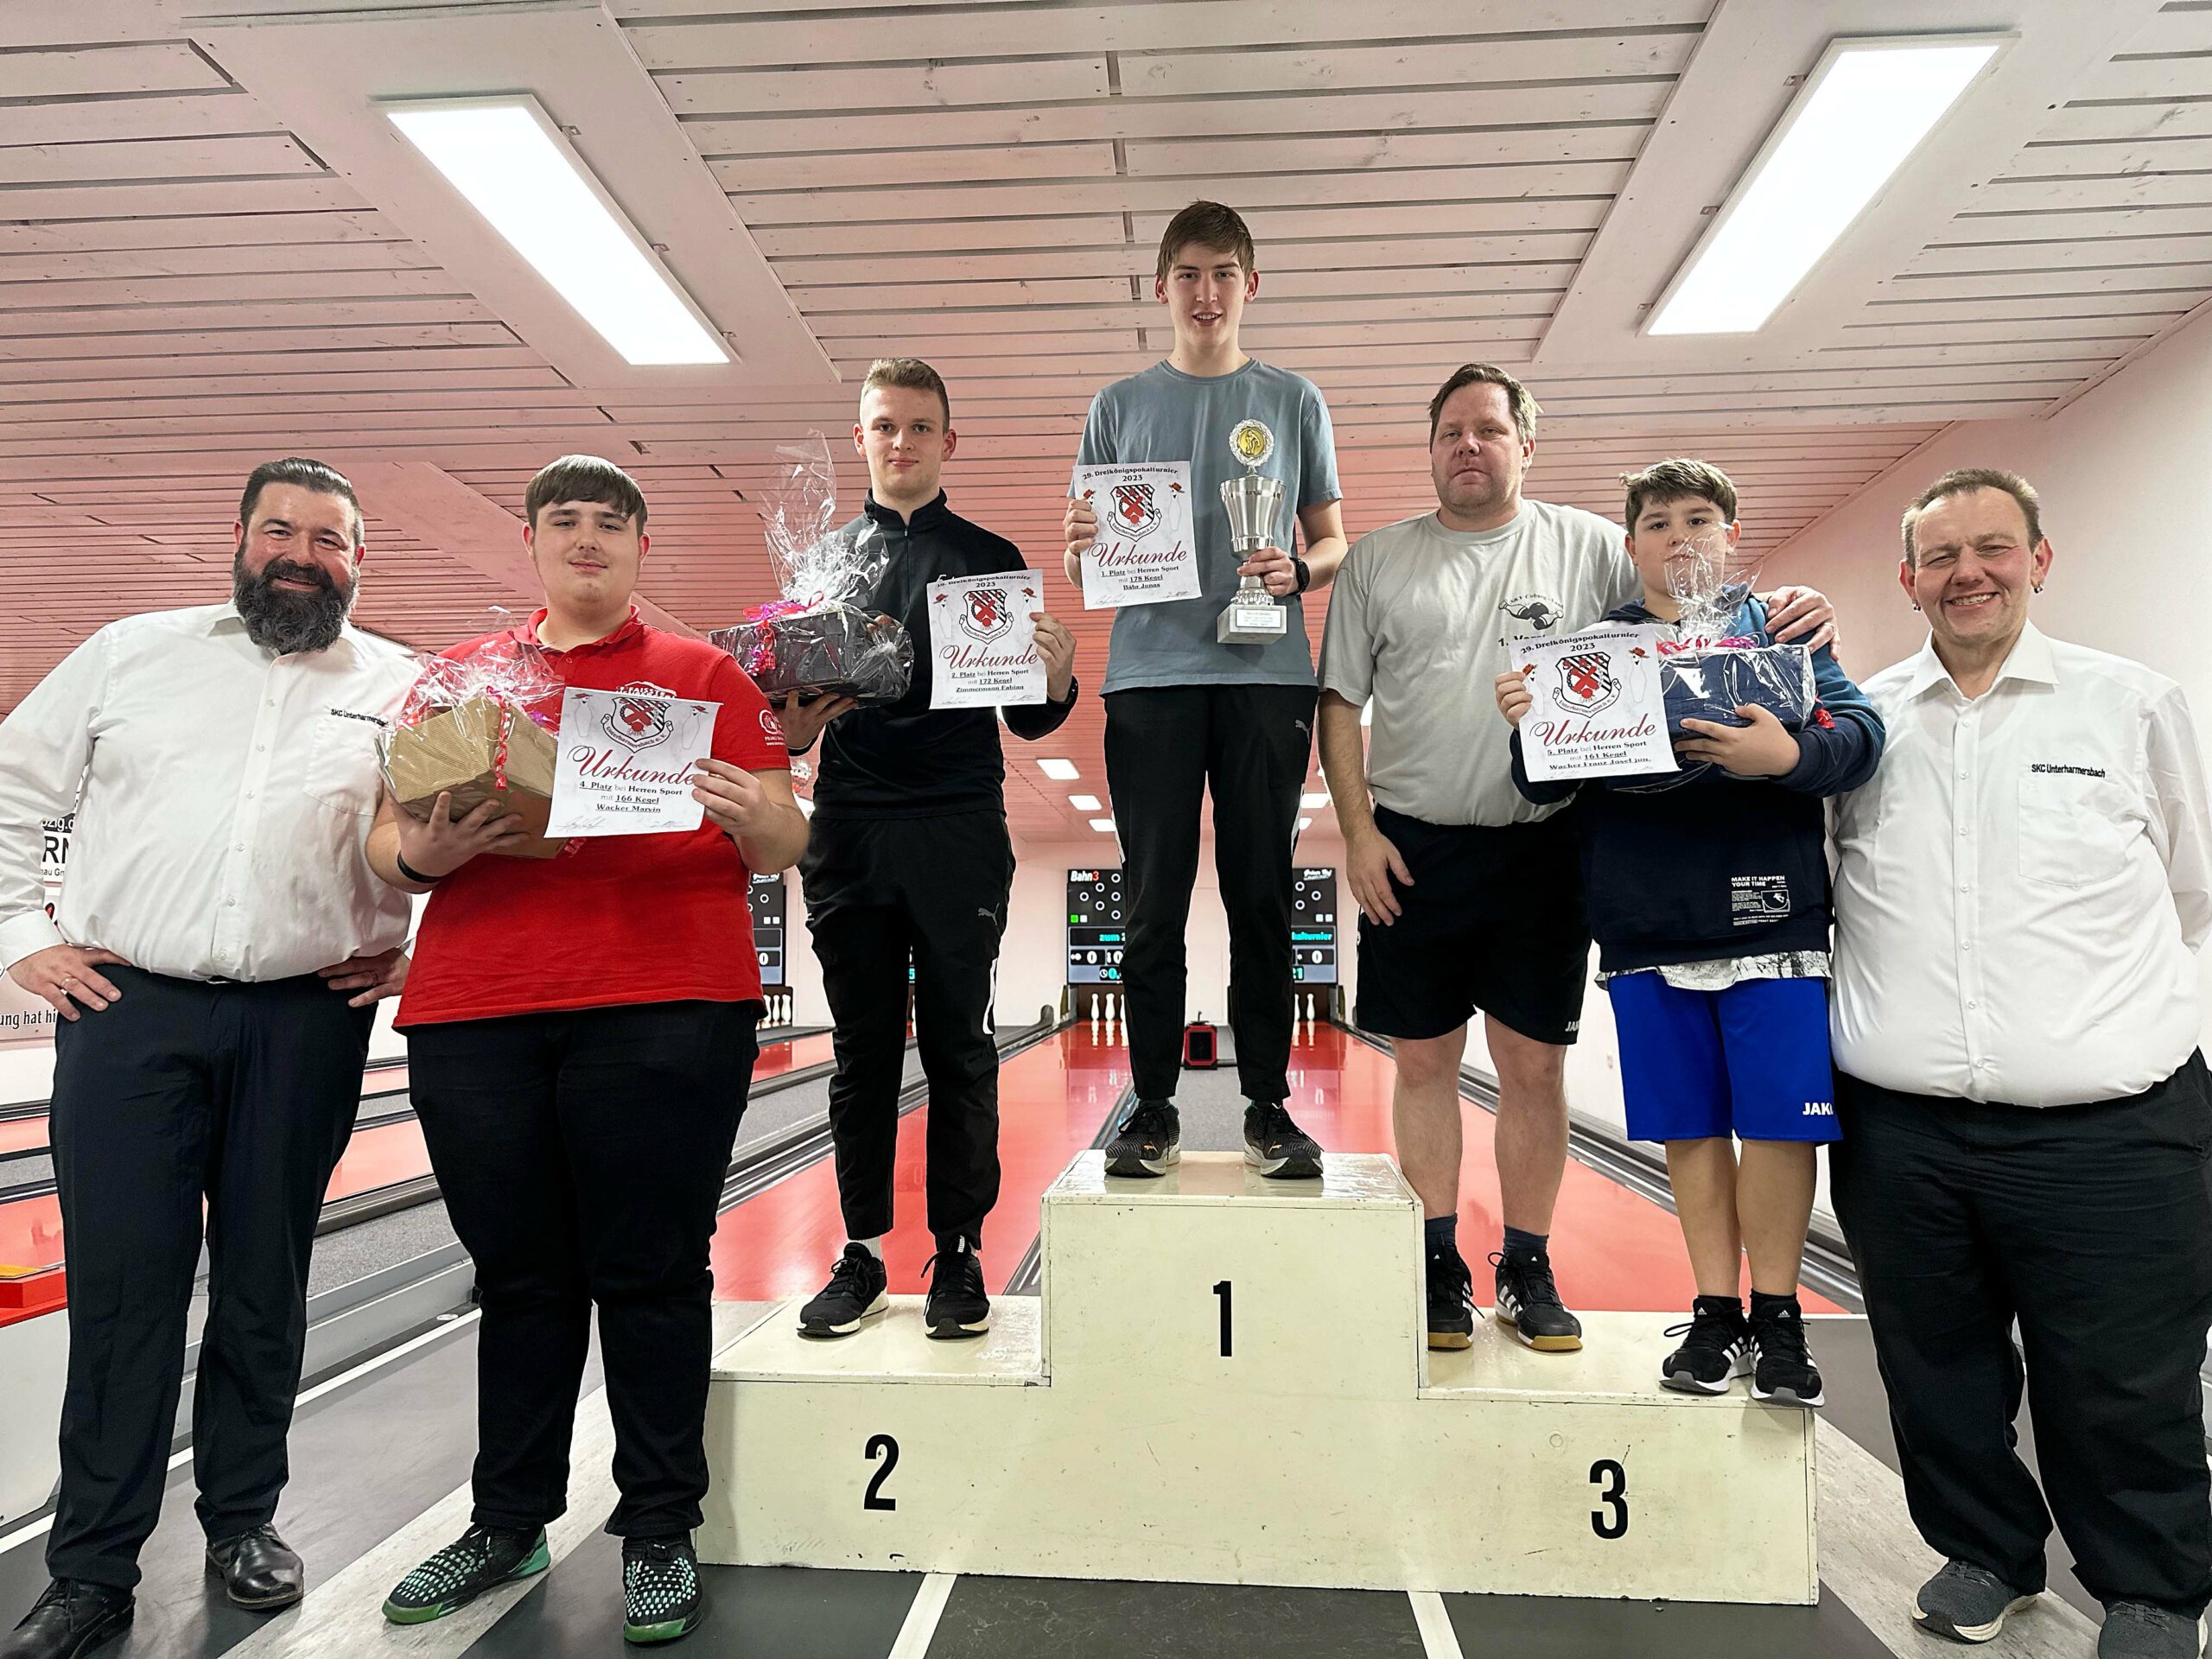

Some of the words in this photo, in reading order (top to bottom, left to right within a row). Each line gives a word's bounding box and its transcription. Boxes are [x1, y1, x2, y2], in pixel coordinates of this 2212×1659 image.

[1095, 467, 1179, 477] Dreikönigspokalturnier
[1087, 541, 1187, 567] Urkunde
[1498, 638, 1509, 646] 1.
[1535, 632, 1640, 649] Dreikönigspokalturnier
[1570, 643, 1595, 652] 2023
[939, 644, 1037, 669] Urkunde
[331, 709, 342, 717] SKC
[1529, 714, 1657, 747] Urkunde
[567, 746, 694, 785] Urkunde
[2031, 764, 2046, 772] SKC
[2047, 764, 2105, 778] Unterharmersbach
[1087, 950, 1097, 964] 0
[1312, 950, 1322, 963] 0
[23, 1011, 41, 1025] hat
[1211, 1280, 1232, 1357] 1
[863, 1434, 899, 1511] 2
[1589, 1459, 1629, 1540] 3
